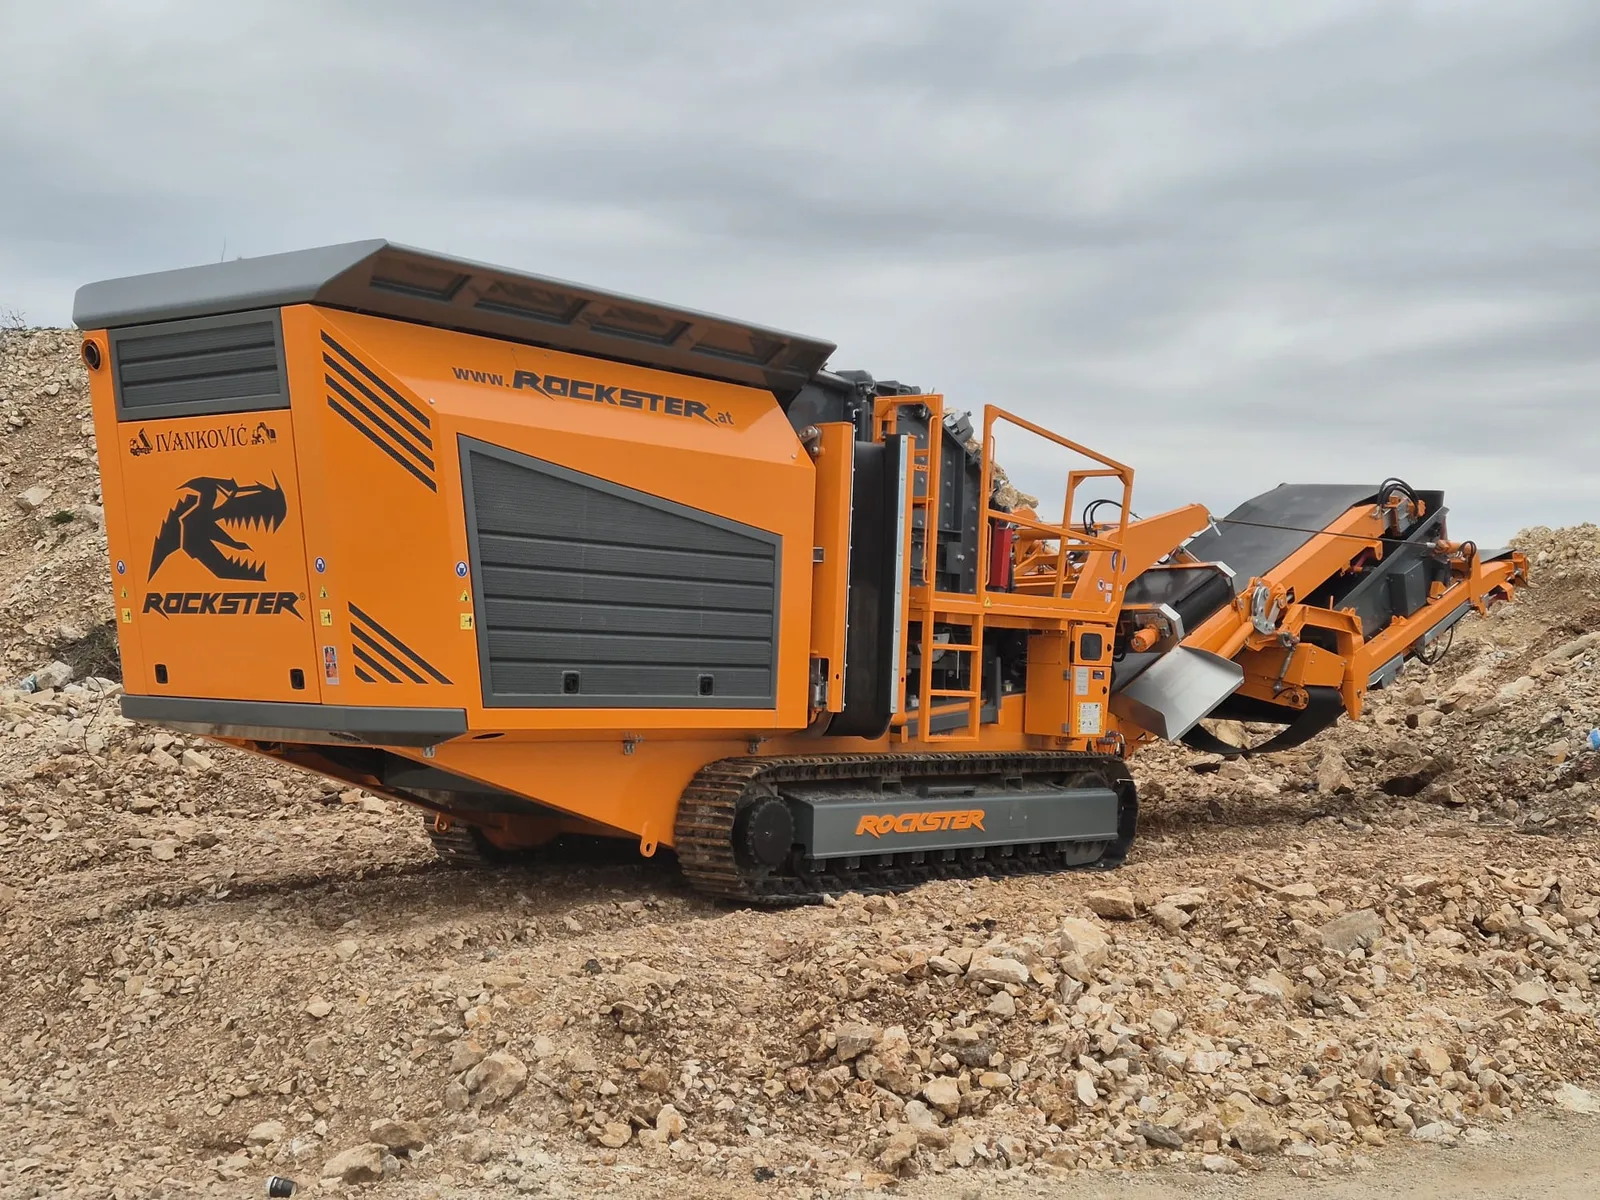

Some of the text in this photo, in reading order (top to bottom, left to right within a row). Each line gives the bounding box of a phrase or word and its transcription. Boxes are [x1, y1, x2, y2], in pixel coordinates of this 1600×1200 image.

[156, 423, 249, 452] IVANKOVIĆ
[142, 591, 305, 622] ROCKSTER
[855, 809, 986, 839] ROCKSTER
